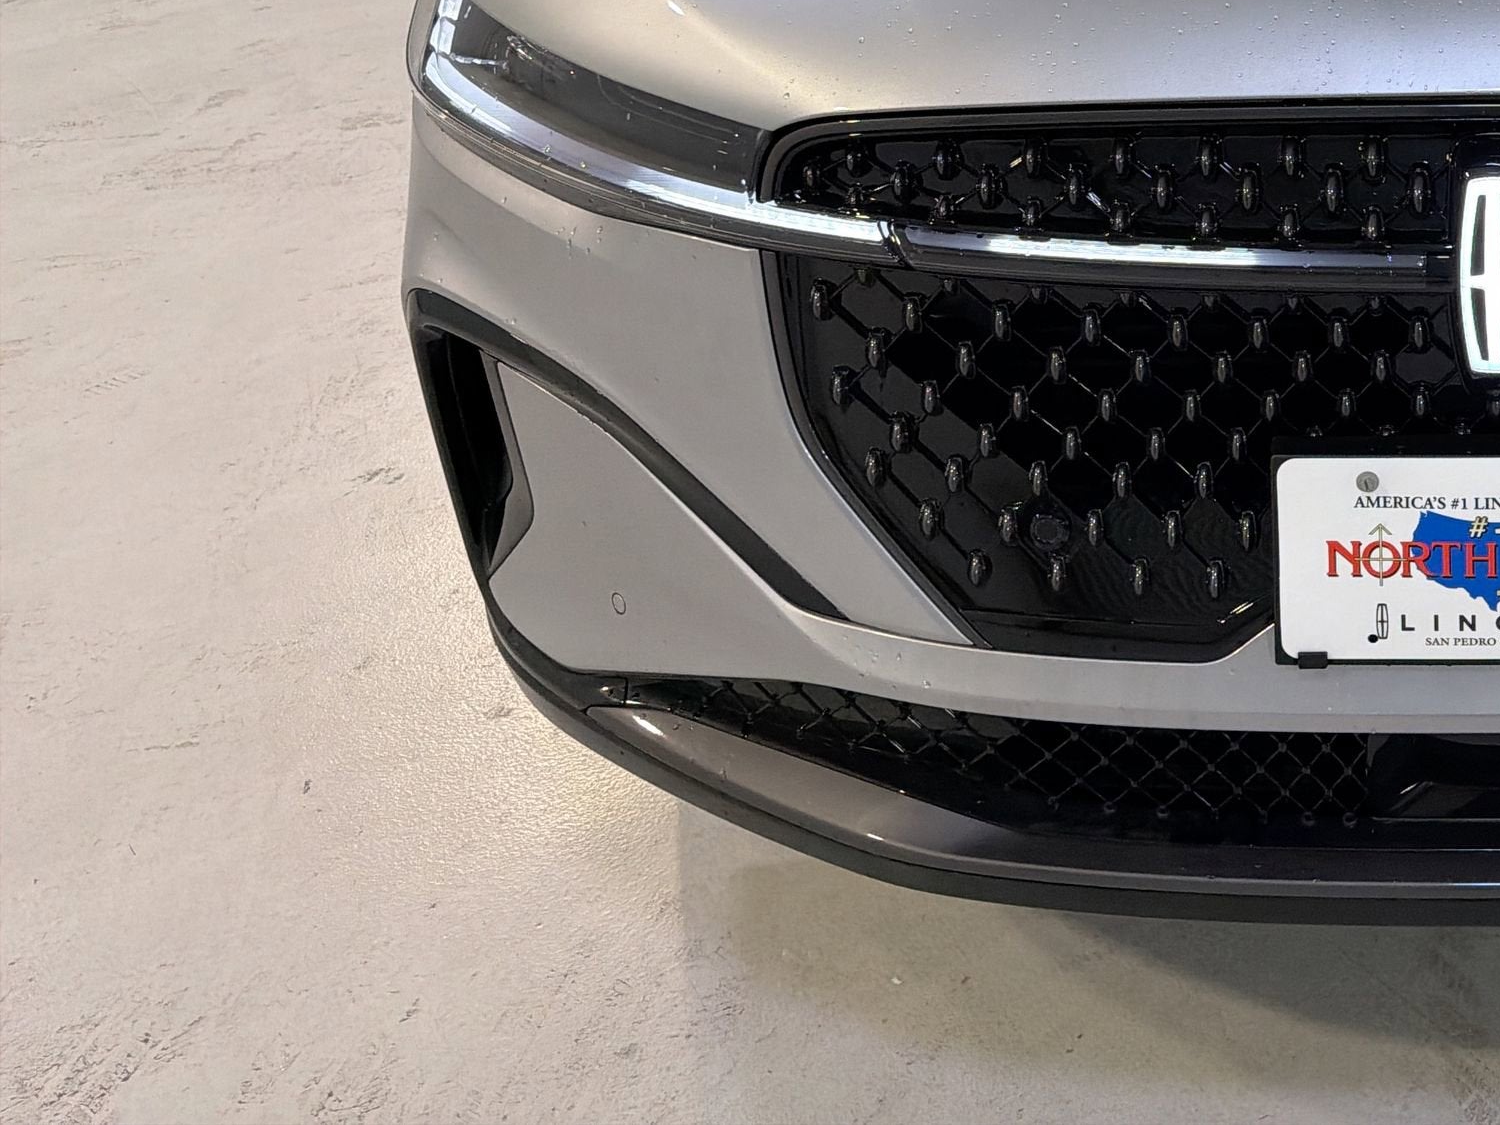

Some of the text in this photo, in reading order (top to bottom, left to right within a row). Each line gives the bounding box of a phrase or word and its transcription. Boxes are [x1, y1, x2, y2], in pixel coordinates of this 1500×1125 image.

[1353, 495, 1446, 510] AMERICA'S
[1450, 497, 1469, 510] #1
[1325, 539, 1498, 579] NORTH
[1425, 637, 1450, 647] SAN
[1453, 637, 1497, 647] PEDRO
